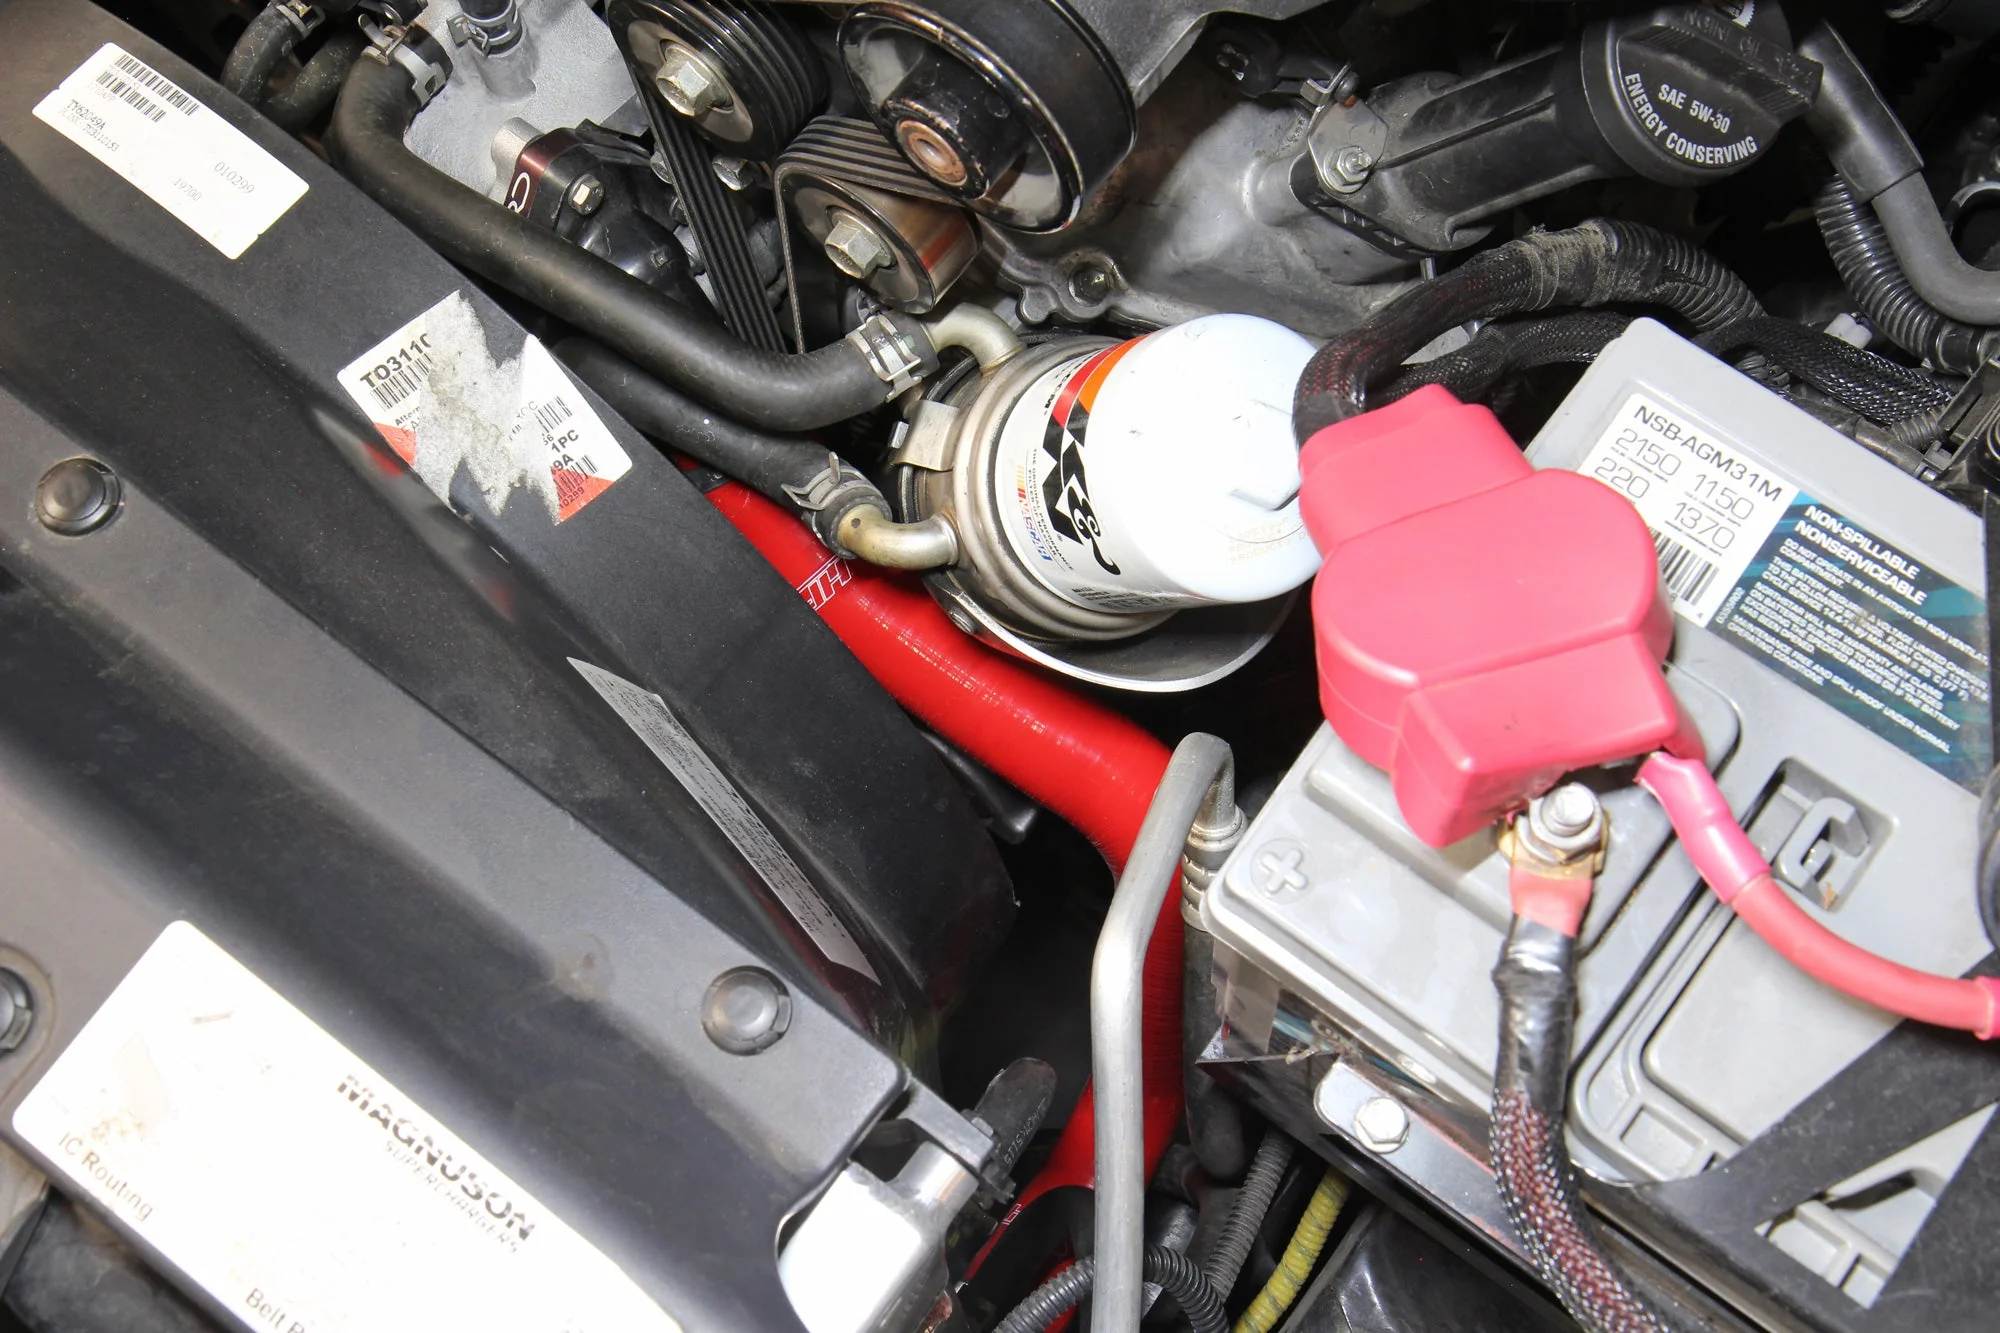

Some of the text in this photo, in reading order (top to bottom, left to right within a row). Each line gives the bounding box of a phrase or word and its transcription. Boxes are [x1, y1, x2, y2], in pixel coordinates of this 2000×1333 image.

[1624, 73, 1758, 165] ENERGY CONSERVING
[1658, 84, 1731, 134] SAE 5W-30
[173, 178, 202, 201] 19700
[214, 161, 255, 194] 010299
[551, 429, 579, 453] 1PC
[1615, 428, 1682, 476] 2150
[1634, 405, 1783, 502] NSB-AGM31M
[1594, 457, 1650, 498] 220
[1695, 474, 1754, 520] 1150
[1674, 501, 1735, 549] 1370
[1804, 505, 1920, 579] NON-SPILLABLE
[1794, 520, 1928, 605] NONSERVICEABLE
[1945, 634, 1990, 665] VENTILAT
[58, 1132, 153, 1223] IC Routing
[337, 1074, 536, 1241] MAGNUSON
[246, 1288, 286, 1329] Belt
